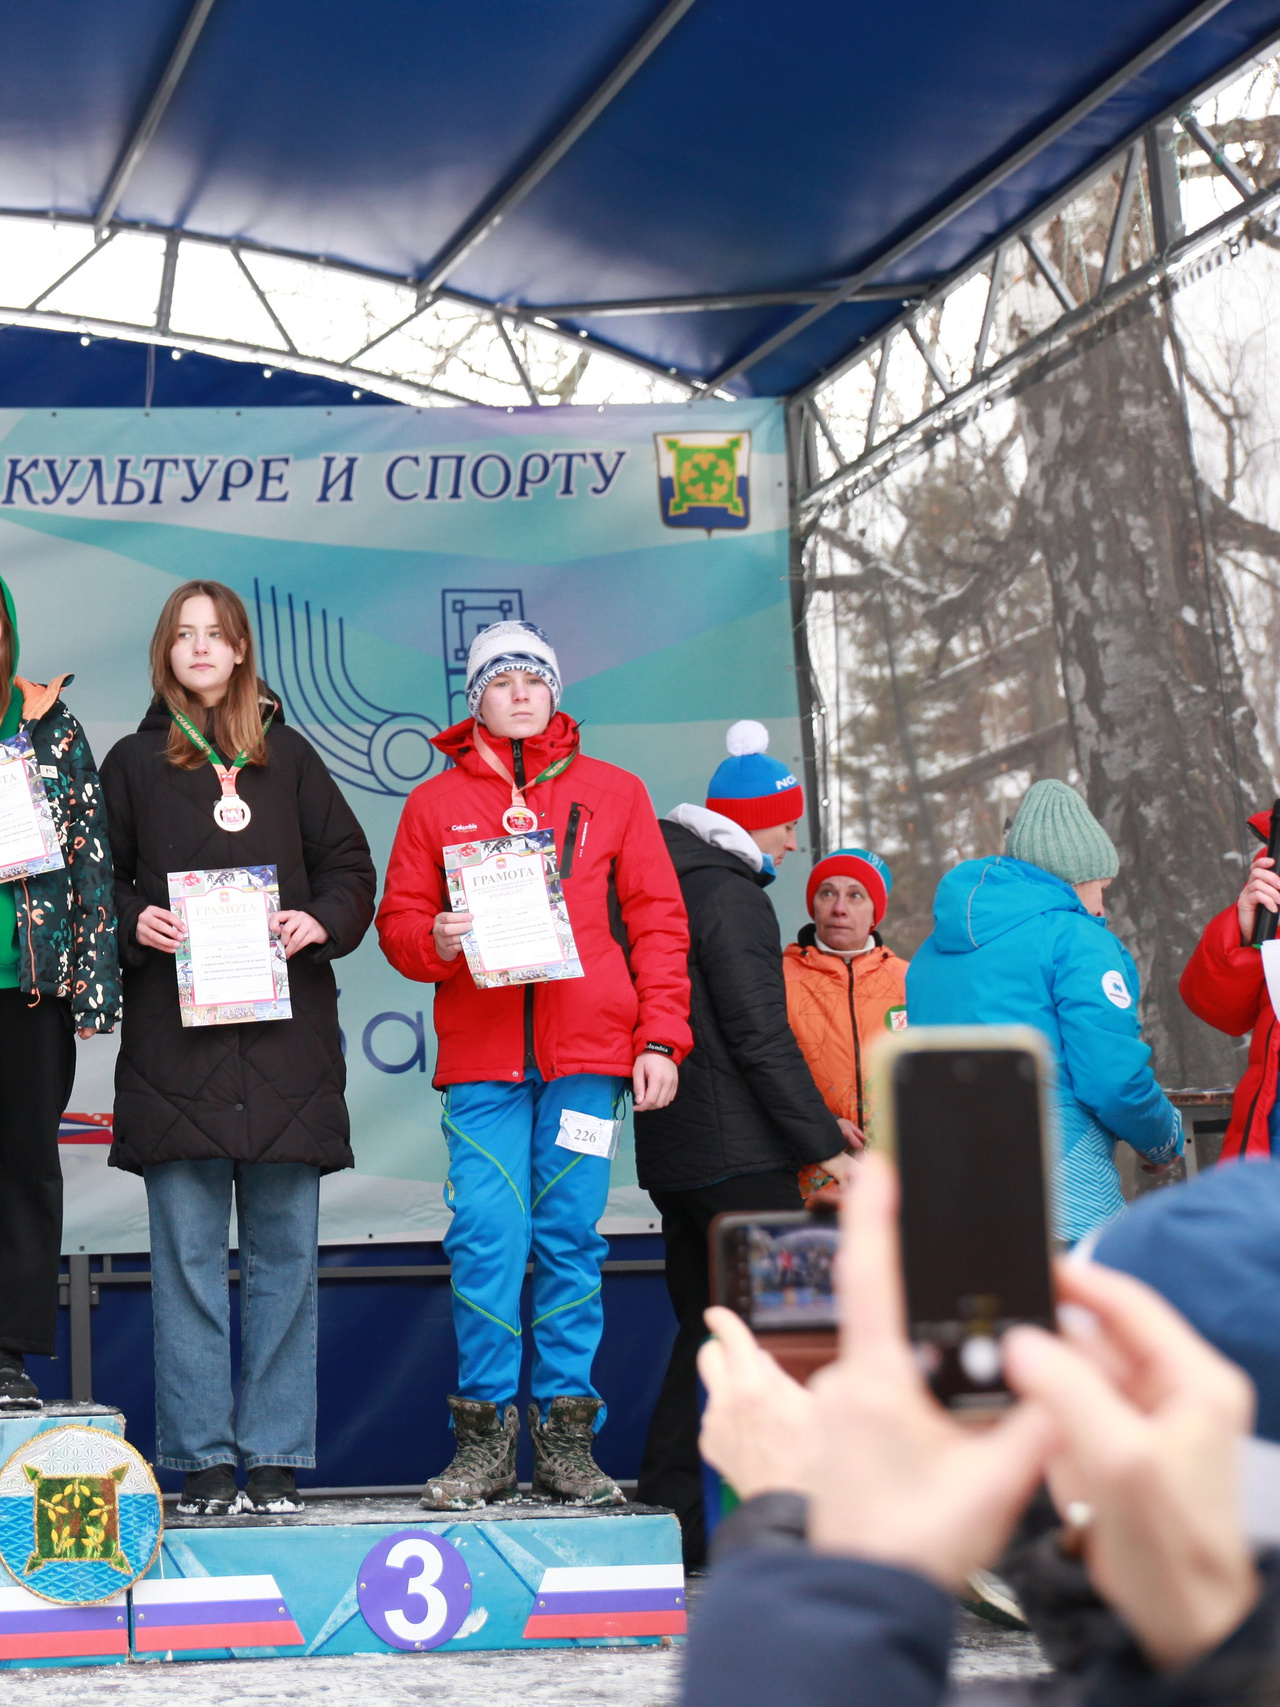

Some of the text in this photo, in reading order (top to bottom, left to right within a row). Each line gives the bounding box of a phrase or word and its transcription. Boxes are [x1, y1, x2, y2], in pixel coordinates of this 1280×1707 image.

[1, 454, 290, 506] КУЛЬТУРЕ
[316, 455, 360, 502] И
[385, 450, 627, 502] СПОРТУ
[775, 774, 798, 790] NO
[472, 867, 535, 887] ГРАМОТА
[195, 903, 257, 917] ГРАМОТА
[574, 1128, 597, 1143] 226
[384, 1538, 448, 1641] 3
